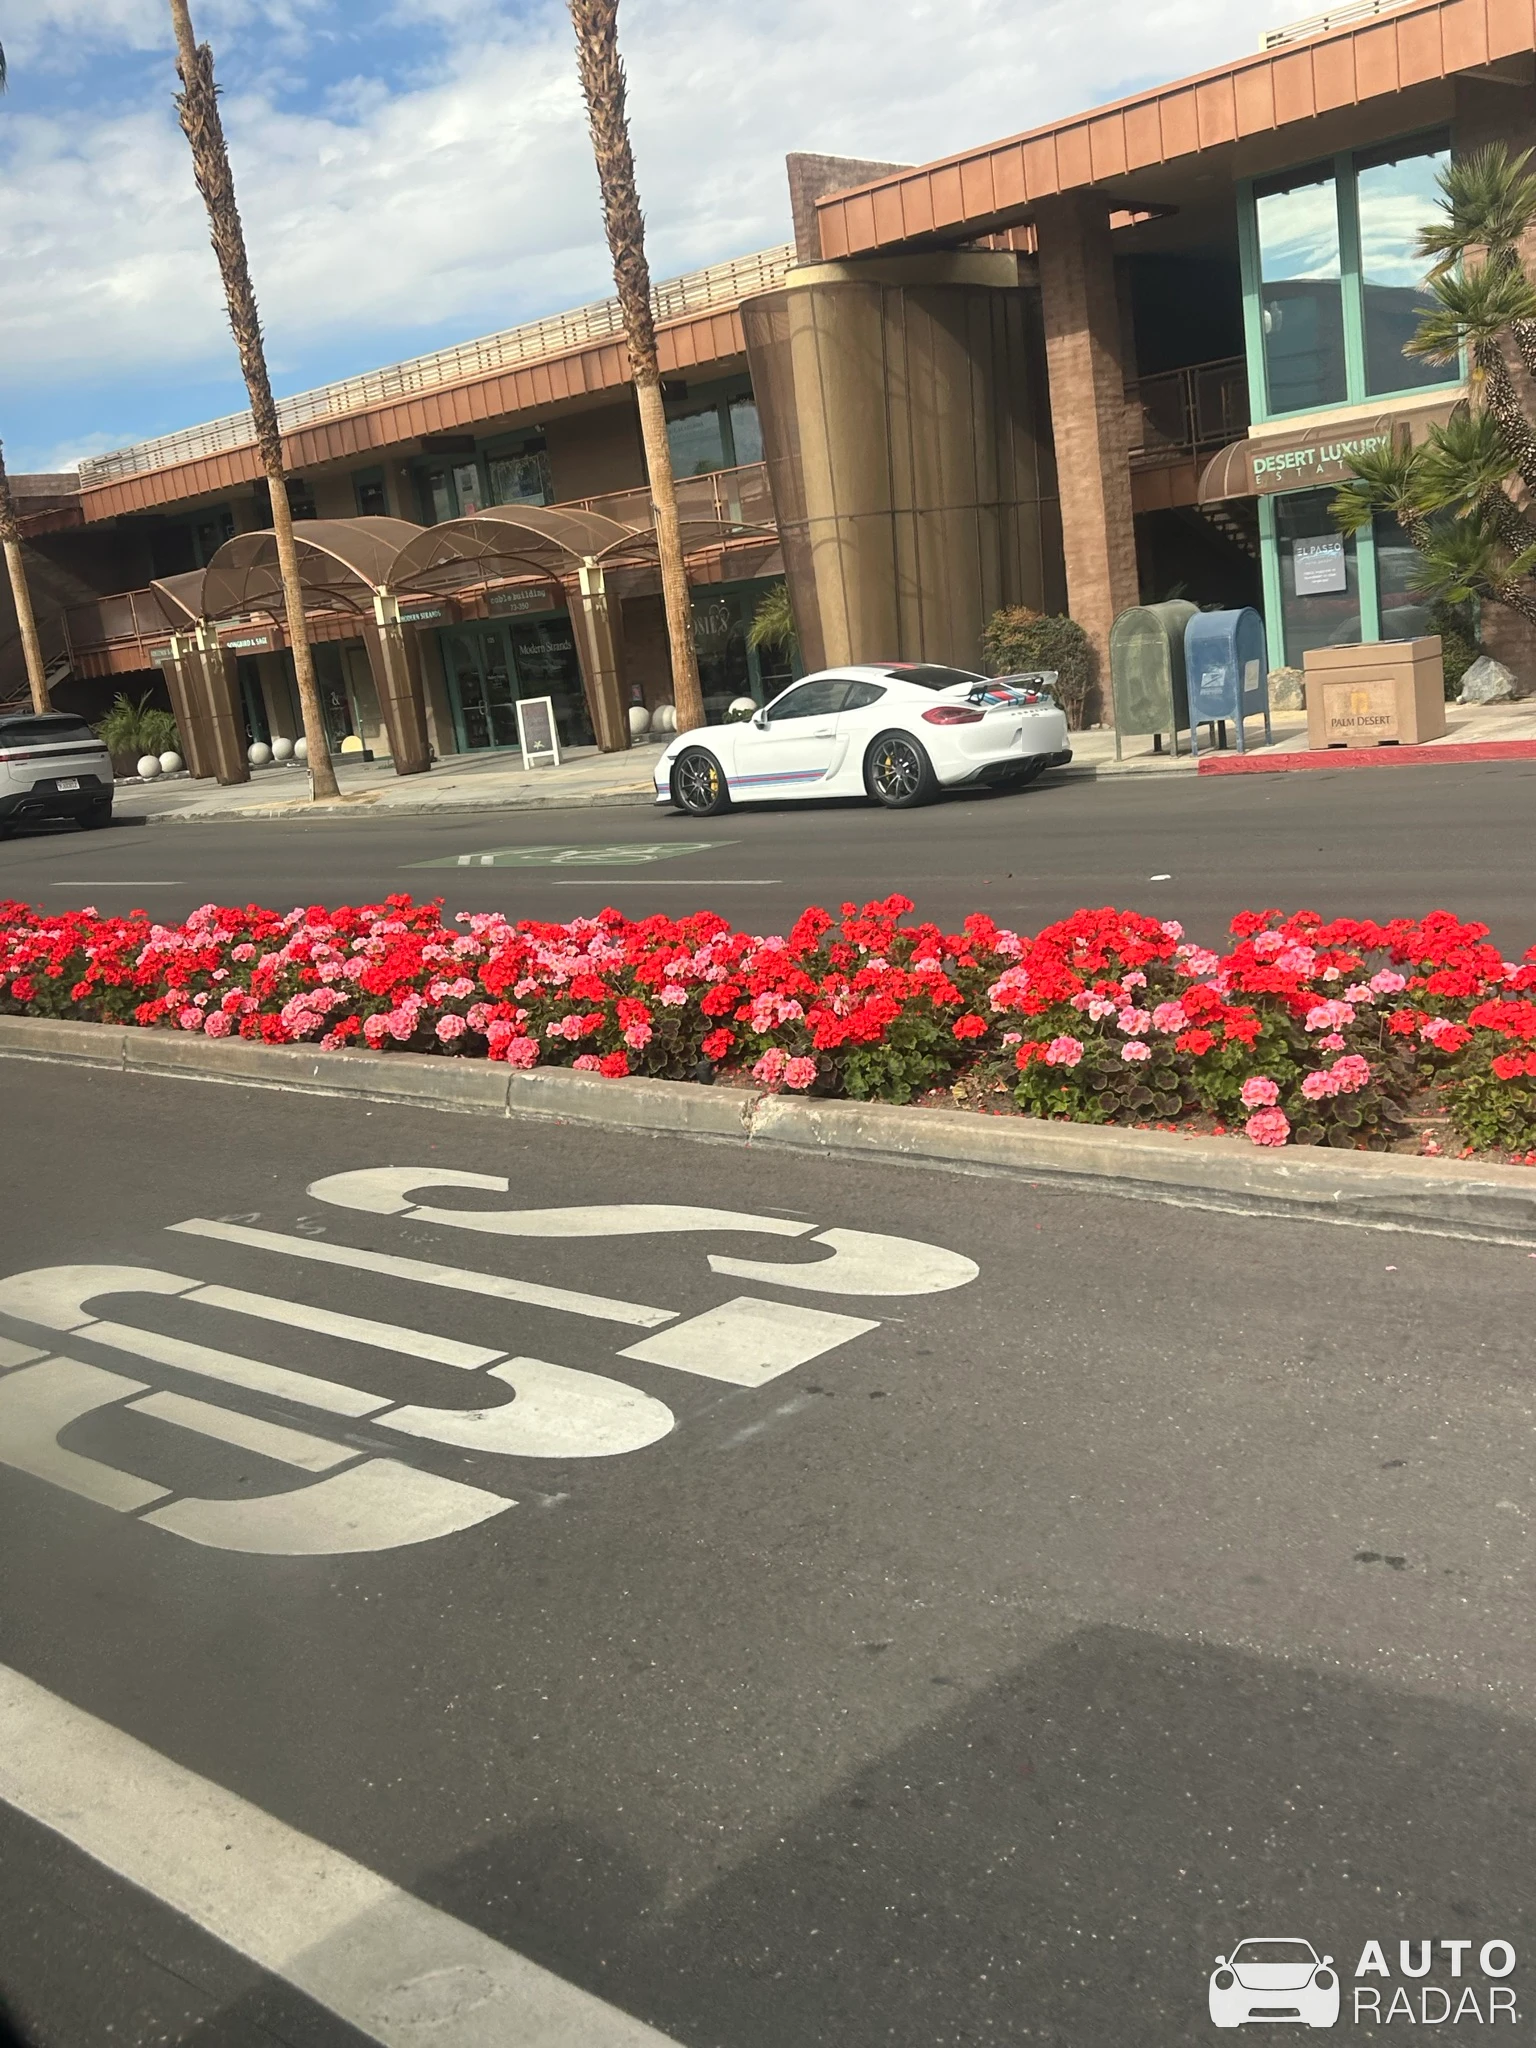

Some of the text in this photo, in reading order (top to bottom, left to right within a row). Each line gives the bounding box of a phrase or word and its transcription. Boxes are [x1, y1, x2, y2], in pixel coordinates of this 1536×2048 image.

[1253, 436, 1389, 475] DESERT LUXURY
[1255, 461, 1344, 485] ESTAT
[1297, 542, 1341, 557] EL PASEO
[518, 639, 571, 656] Modern Strands
[1331, 715, 1391, 727] PALM DESERT
